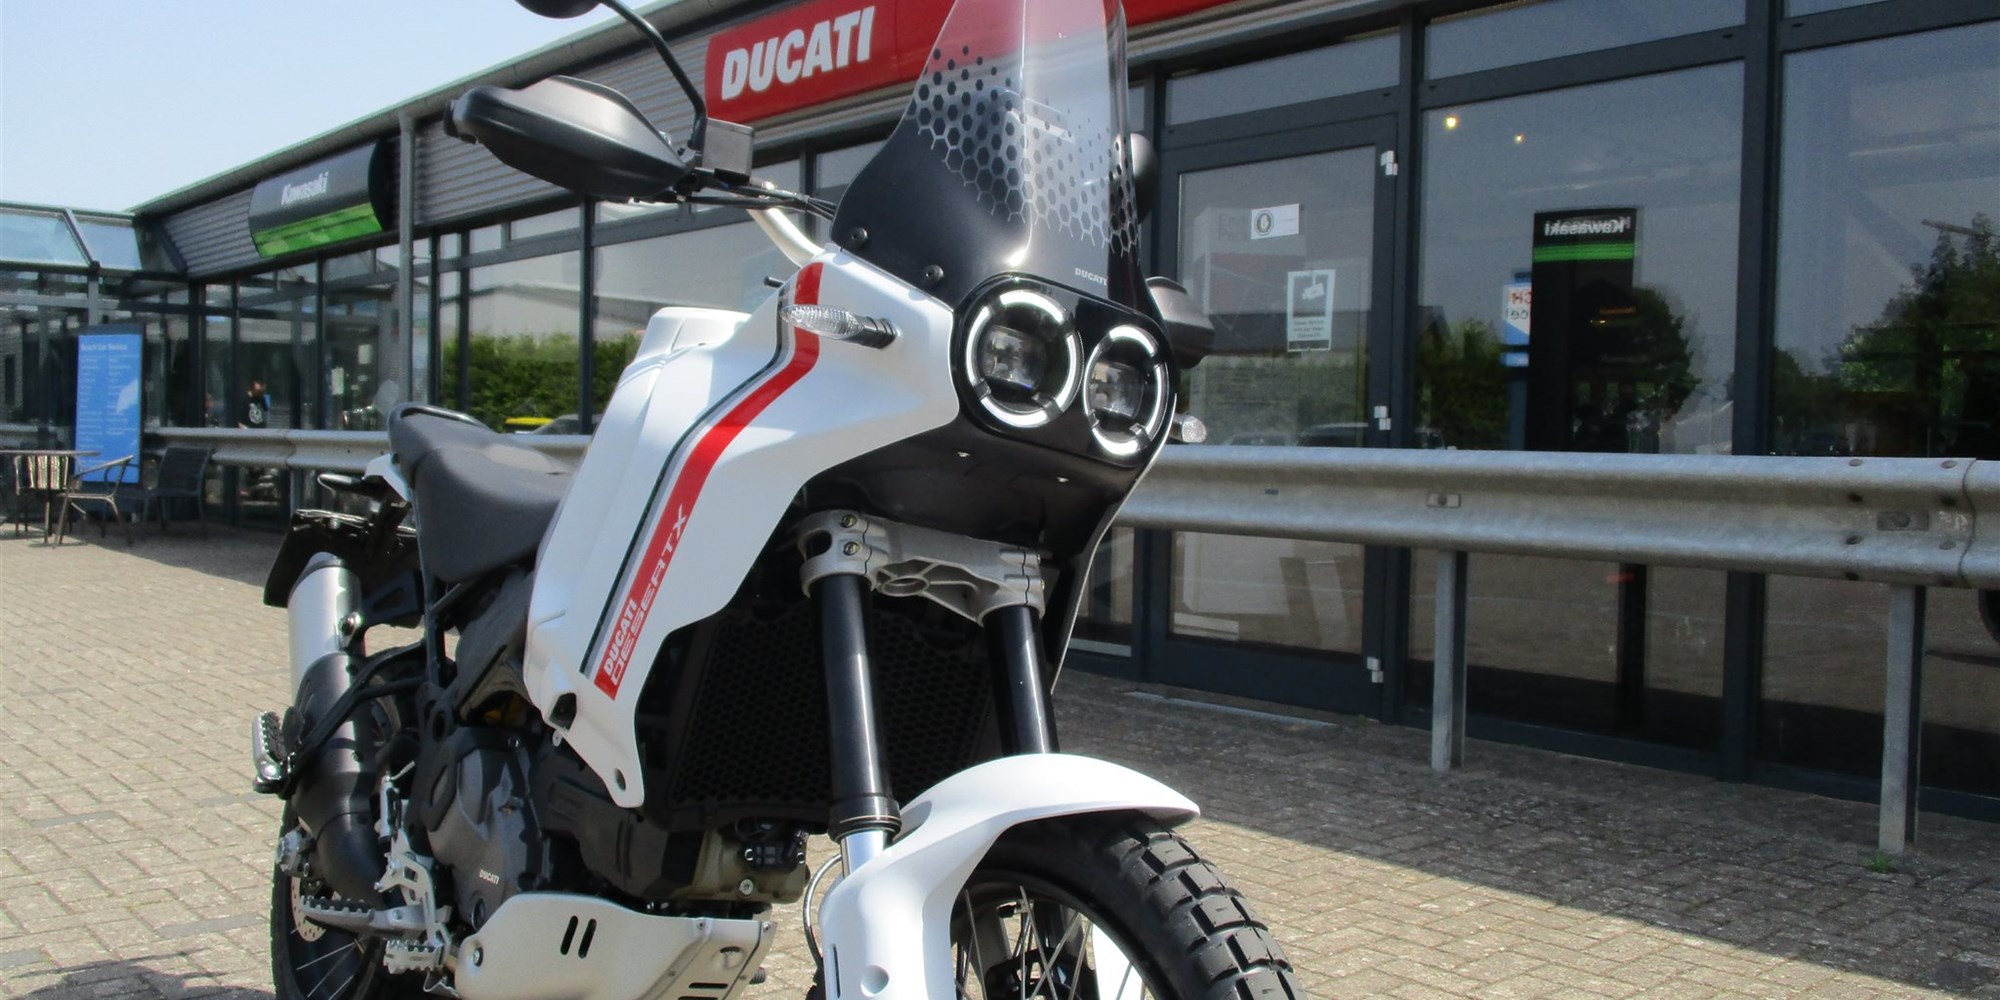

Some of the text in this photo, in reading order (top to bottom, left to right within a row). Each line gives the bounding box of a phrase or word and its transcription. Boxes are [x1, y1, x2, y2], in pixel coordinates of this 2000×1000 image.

[721, 5, 876, 101] DUCATI
[281, 171, 329, 205] Kawasaki
[1074, 267, 1108, 287] DUCATI
[611, 503, 687, 686] DESERTX
[603, 598, 638, 675] DUCATI
